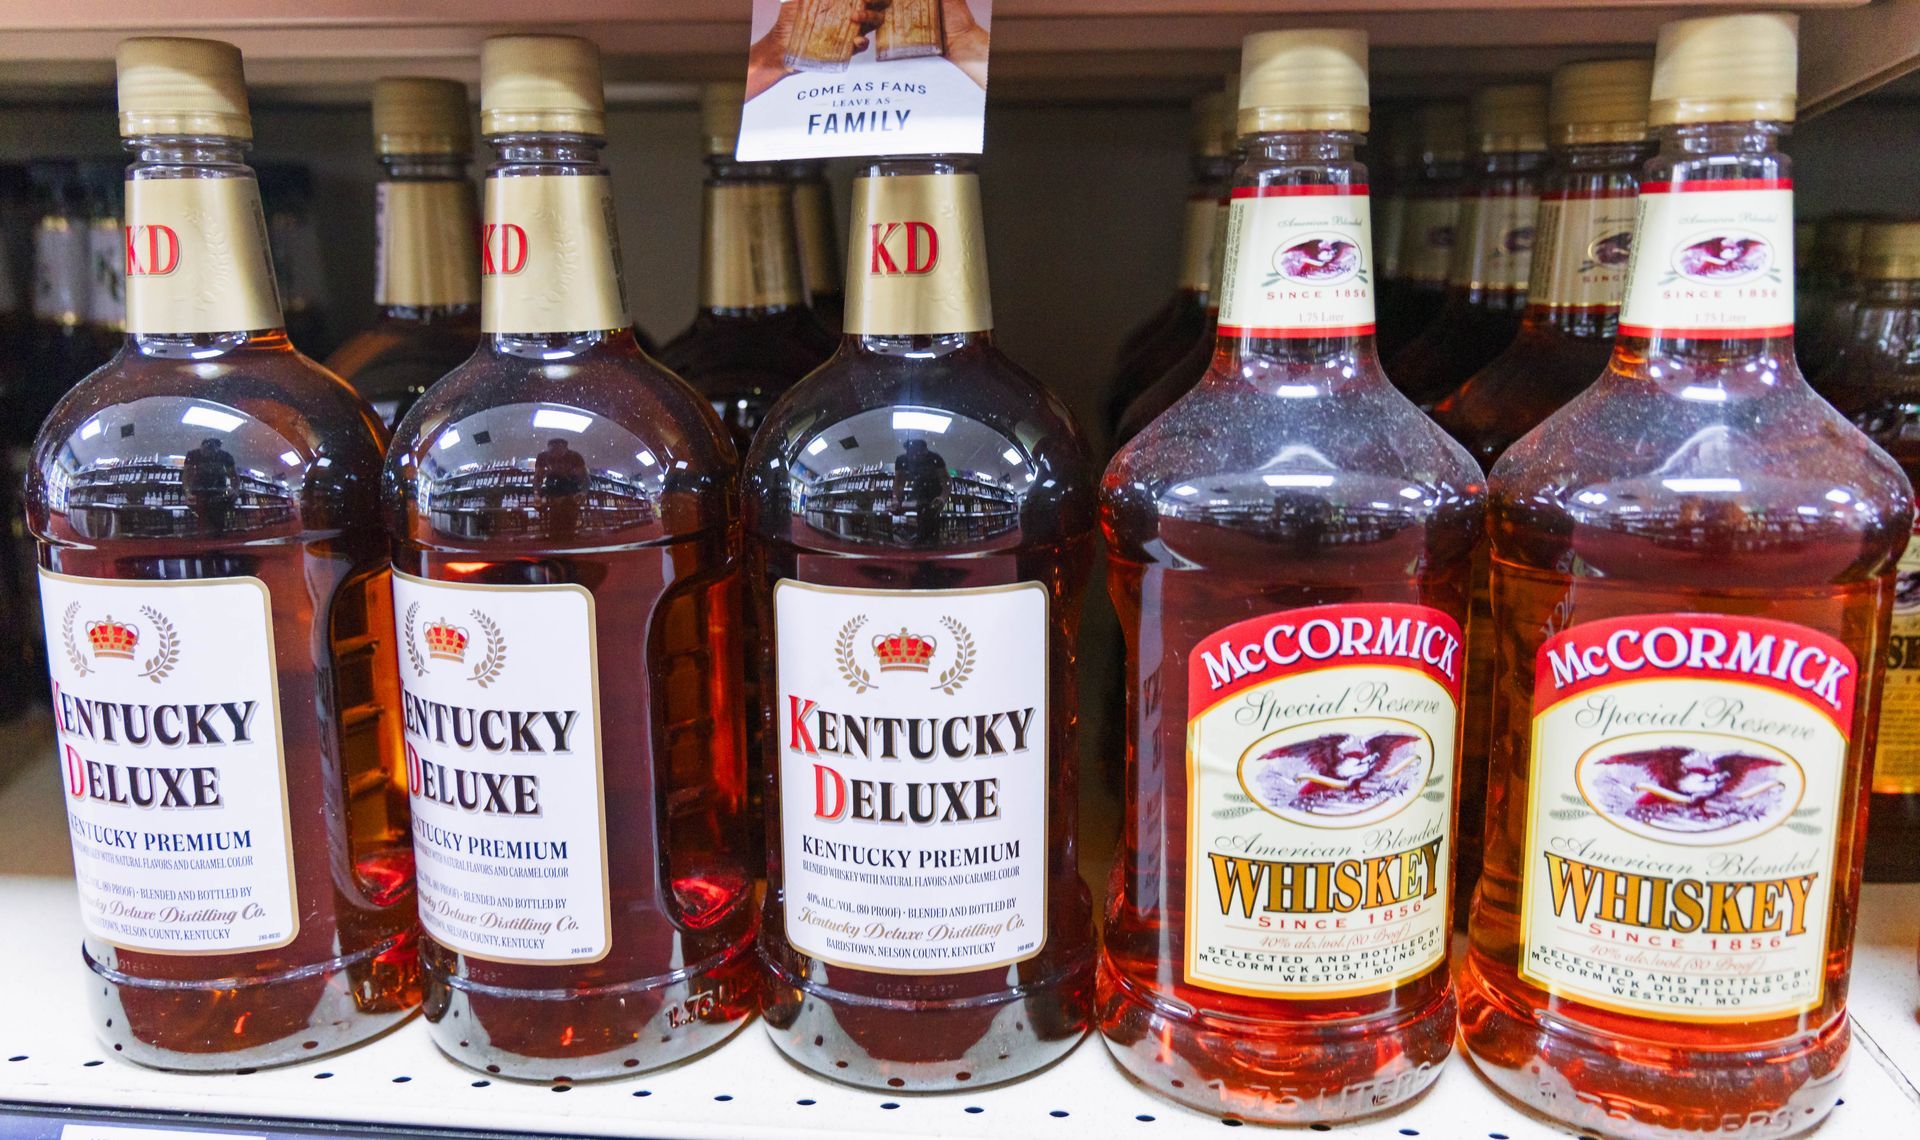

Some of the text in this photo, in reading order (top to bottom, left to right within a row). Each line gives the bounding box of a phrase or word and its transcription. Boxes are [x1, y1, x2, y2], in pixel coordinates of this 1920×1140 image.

[797, 81, 927, 100] COME AS FANS
[832, 97, 891, 107] LEAVE AS
[808, 109, 911, 135] FAMILY
[126, 224, 182, 277] KD
[483, 223, 530, 276] KD
[870, 221, 939, 276] KD
[1267, 289, 1366, 300] SINCE 1856
[1663, 290, 1722, 299] SINCE
[1201, 617, 1459, 689] McCORMICK
[1547, 626, 1849, 704] McCORMICK
[1235, 681, 1440, 731] Special Reserve
[1575, 695, 1815, 741] Special Reserve
[788, 694, 1035, 762] KENTUCKY
[65, 743, 224, 809] DELUXE
[407, 741, 543, 817] DELUXE
[813, 763, 1001, 826] DELUXE
[144, 829, 252, 852] PREMIUM
[468, 836, 568, 860] PREMIUM
[1215, 812, 1441, 857] American Blended
[115, 855, 142, 868] NATURAL
[143, 857, 172, 870] FLAVORS
[174, 859, 189, 870] AND
[190, 857, 226, 870] CARAMEL
[227, 855, 254, 868] COLOR
[802, 834, 1020, 868] KENTUCKY PREMIUM
[1550, 837, 1820, 877] American Blended
[467, 861, 494, 876] FLAVORS
[494, 865, 508, 877] AND
[509, 866, 543, 878] CARAMEL
[544, 867, 569, 878] COLOR
[802, 860, 1020, 888] BLENDED WHISKEY WITH NATURAL FLAVORS AND CARAMEL COLOR
[1208, 835, 1443, 919] WHISKEY
[141, 888, 176, 900] BLENDED
[178, 890, 196, 900] AND
[198, 887, 238, 900] BOTTLED
[240, 886, 252, 898] BY
[464, 891, 496, 907] BLENDED
[497, 896, 514, 908] AND
[515, 898, 554, 909] BOTTLED
[555, 898, 567, 909] BY
[1544, 850, 1818, 937] WHISKEY
[110, 900, 156, 920] Deluxe
[159, 906, 238, 925] Distilling
[242, 902, 266, 920] Co.
[438, 900, 477, 923] Deluxe
[480, 911, 552, 935] Distilling
[556, 914, 579, 932] Co.
[857, 903, 870, 915] (80
[871, 905, 901, 919] PROOF)
[908, 907, 947, 919] BLENDED
[949, 906, 967, 918] AND
[969, 901, 1005, 915] BOTTLED
[1006, 897, 1016, 909] BY
[1259, 901, 1421, 929] SINCE 1856
[148, 928, 183, 941] COUNTY,
[184, 929, 231, 940] KENTUCKY
[798, 906, 1025, 942] Kentucky Deluxe Distilling Co.
[1589, 923, 1780, 950] SINCE 1856
[470, 931, 500, 948] COUNTY,
[501, 936, 545, 949] KENTUCKY
[826, 937, 996, 959] BARDSTOWN, NELSON COUNTY, KENTUCKY
[1208, 946, 1303, 964] SELECTED
[1315, 955, 1350, 964] AND
[1361, 936, 1424, 960] BOTTLED
[1429, 926, 1440, 938] BY
[1199, 953, 1309, 973] MCCORMICK
[1321, 951, 1415, 972] DISTILLING
[1283, 965, 1394, 982] WESTON, MO
[1531, 951, 1640, 988] MCCORMICK
[1654, 984, 1771, 996] DISTILLING
[1540, 945, 1810, 986] SELECTED AND BOTTLED BY
[1612, 986, 1741, 1006] WESTON, MO
